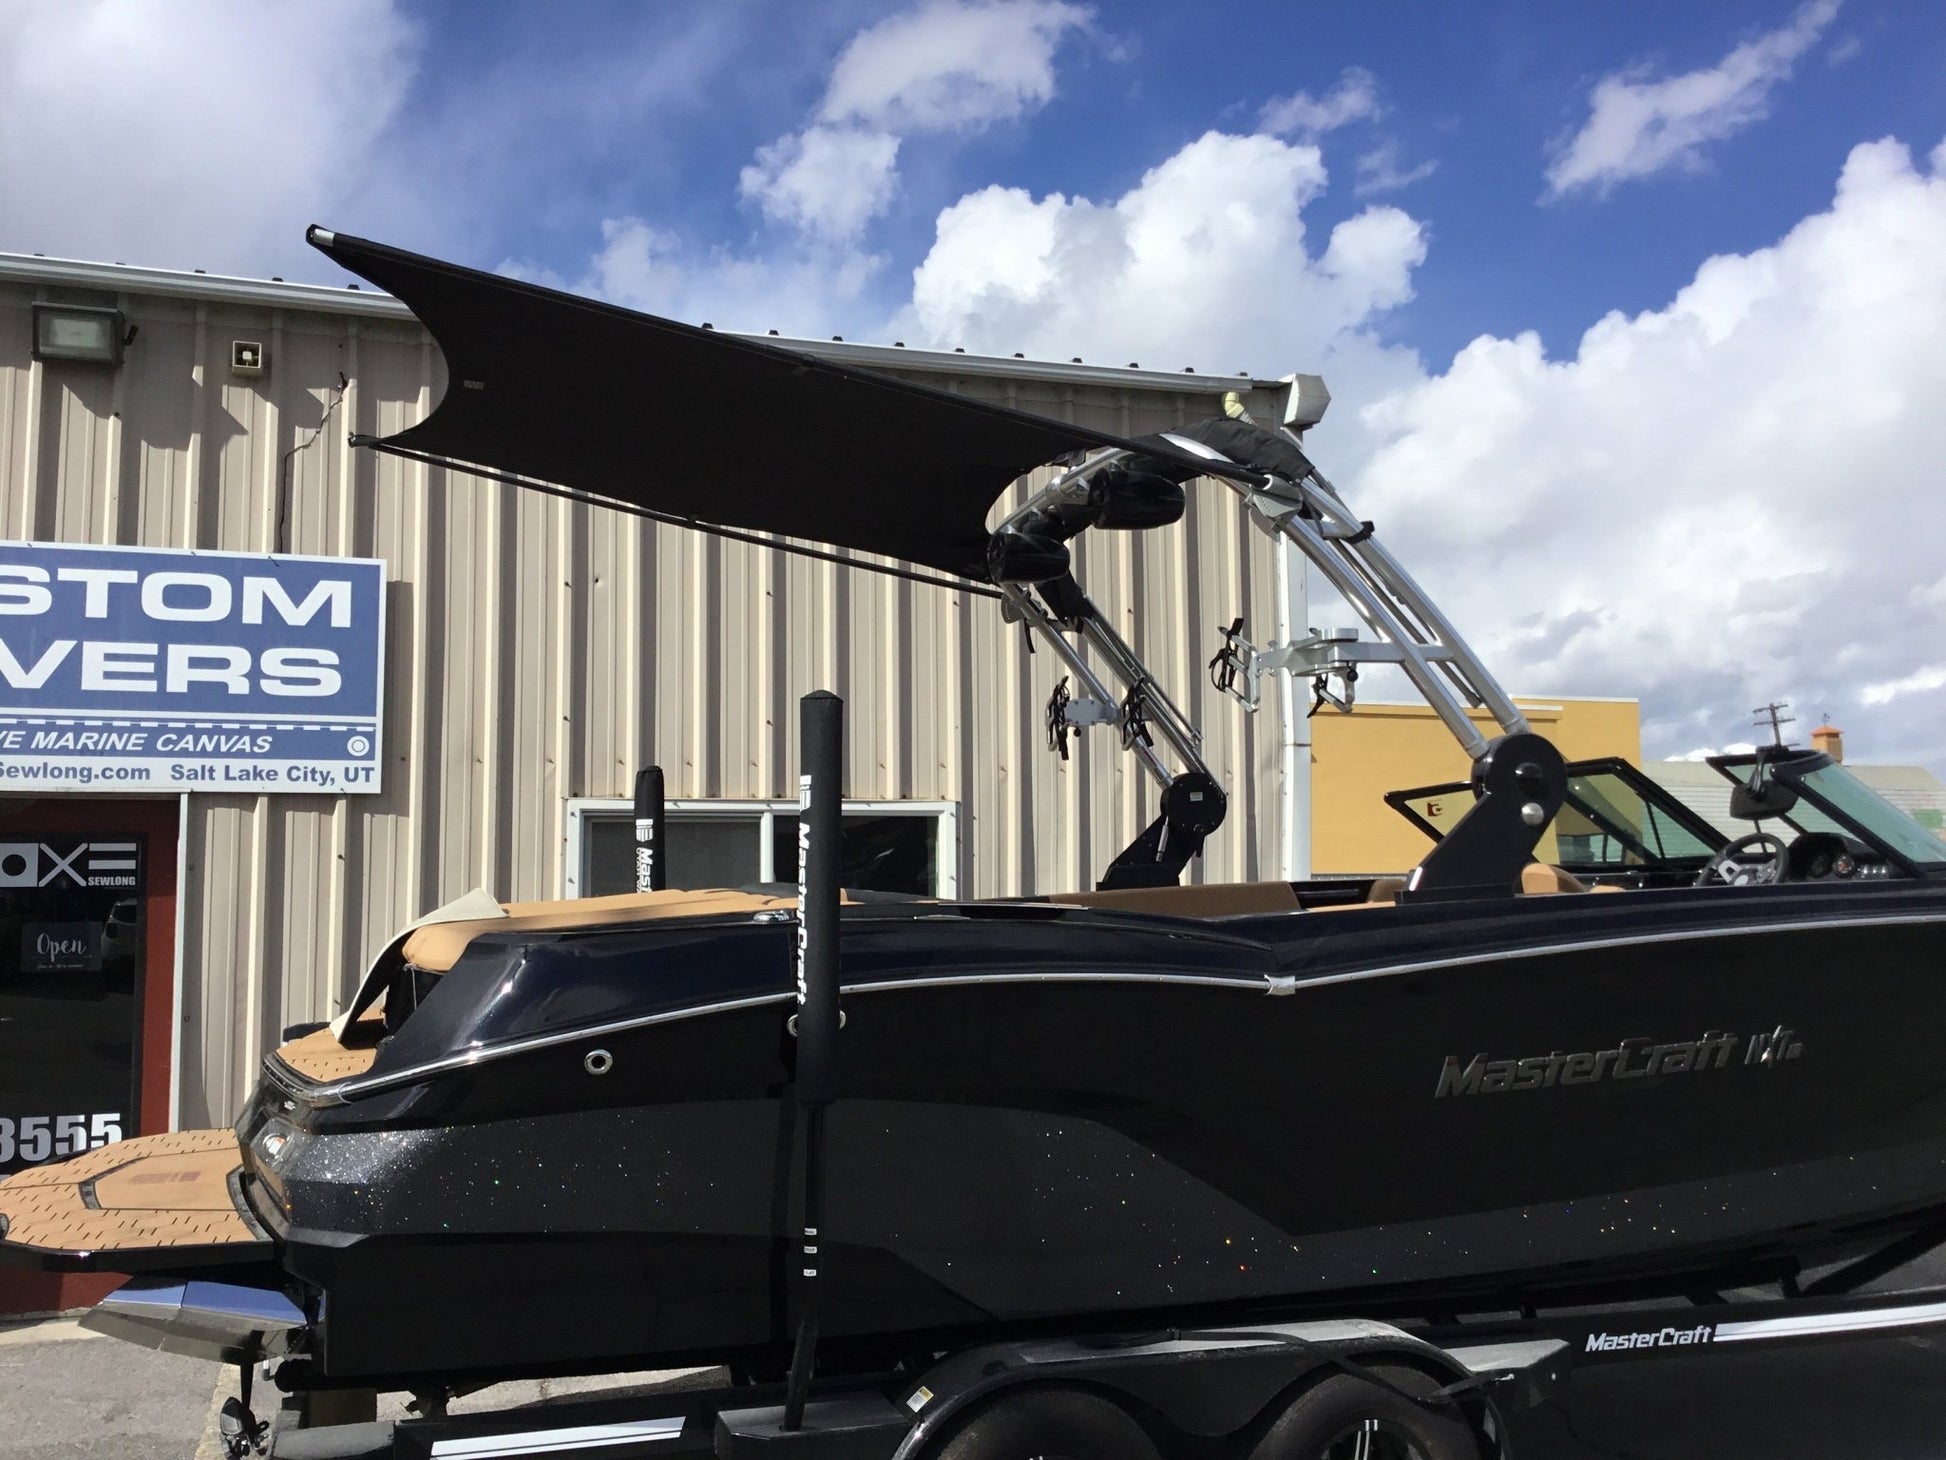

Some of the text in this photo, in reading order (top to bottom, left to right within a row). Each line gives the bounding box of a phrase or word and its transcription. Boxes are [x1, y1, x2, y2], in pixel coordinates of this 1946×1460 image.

[0, 565, 352, 628] STOM
[0, 639, 342, 697] VERS
[30, 730, 148, 751] MARINE
[156, 733, 273, 753] CANVAS
[0, 761, 375, 786] ewlong.com Salt Lake City, UT
[88, 876, 136, 886] SEWLONG
[797, 822, 810, 1005] MasterCraft
[37, 933, 87, 962] Open
[1434, 1030, 1738, 1098] MasterCraft
[1585, 1324, 1713, 1352] MasterCraft
